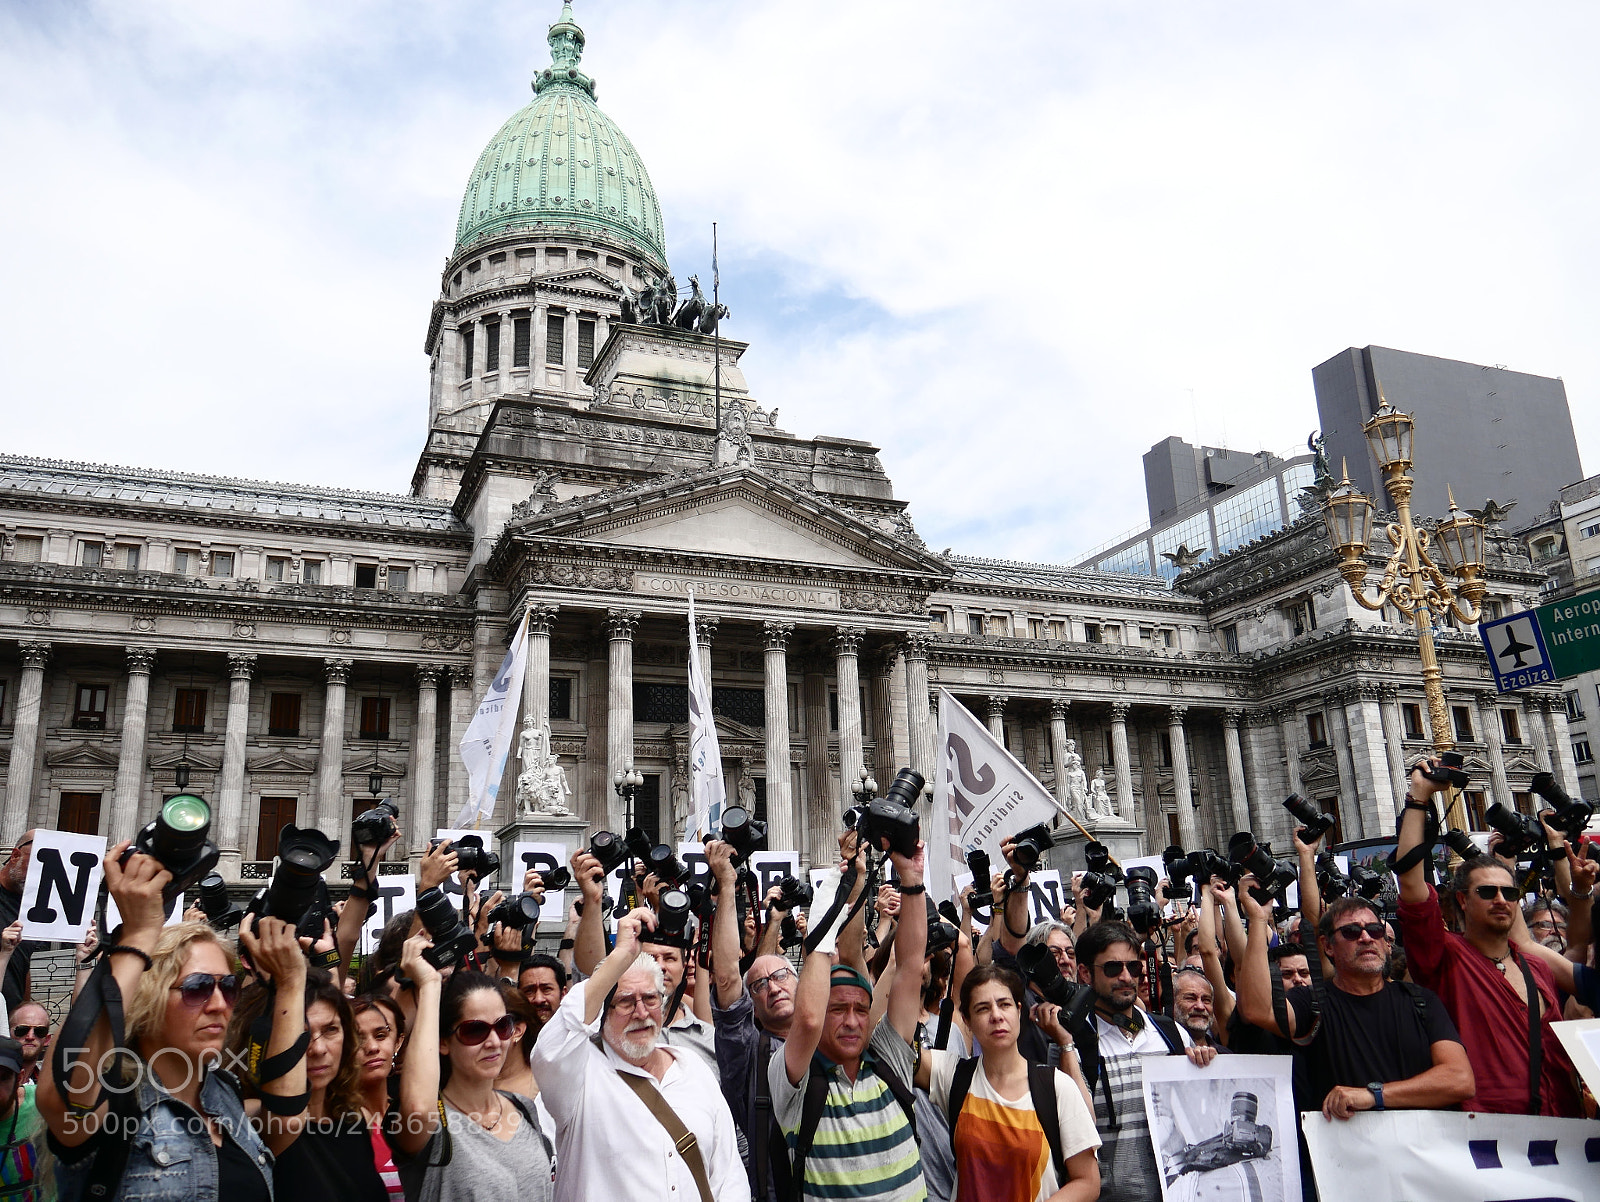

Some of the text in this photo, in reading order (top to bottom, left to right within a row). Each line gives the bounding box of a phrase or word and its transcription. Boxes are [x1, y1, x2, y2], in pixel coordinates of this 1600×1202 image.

[650, 578, 826, 605] CONGRESO NACIONAL
[1500, 669, 1550, 691] Ezeiza
[27, 848, 99, 926] N
[1148, 957, 1156, 974] EOS
